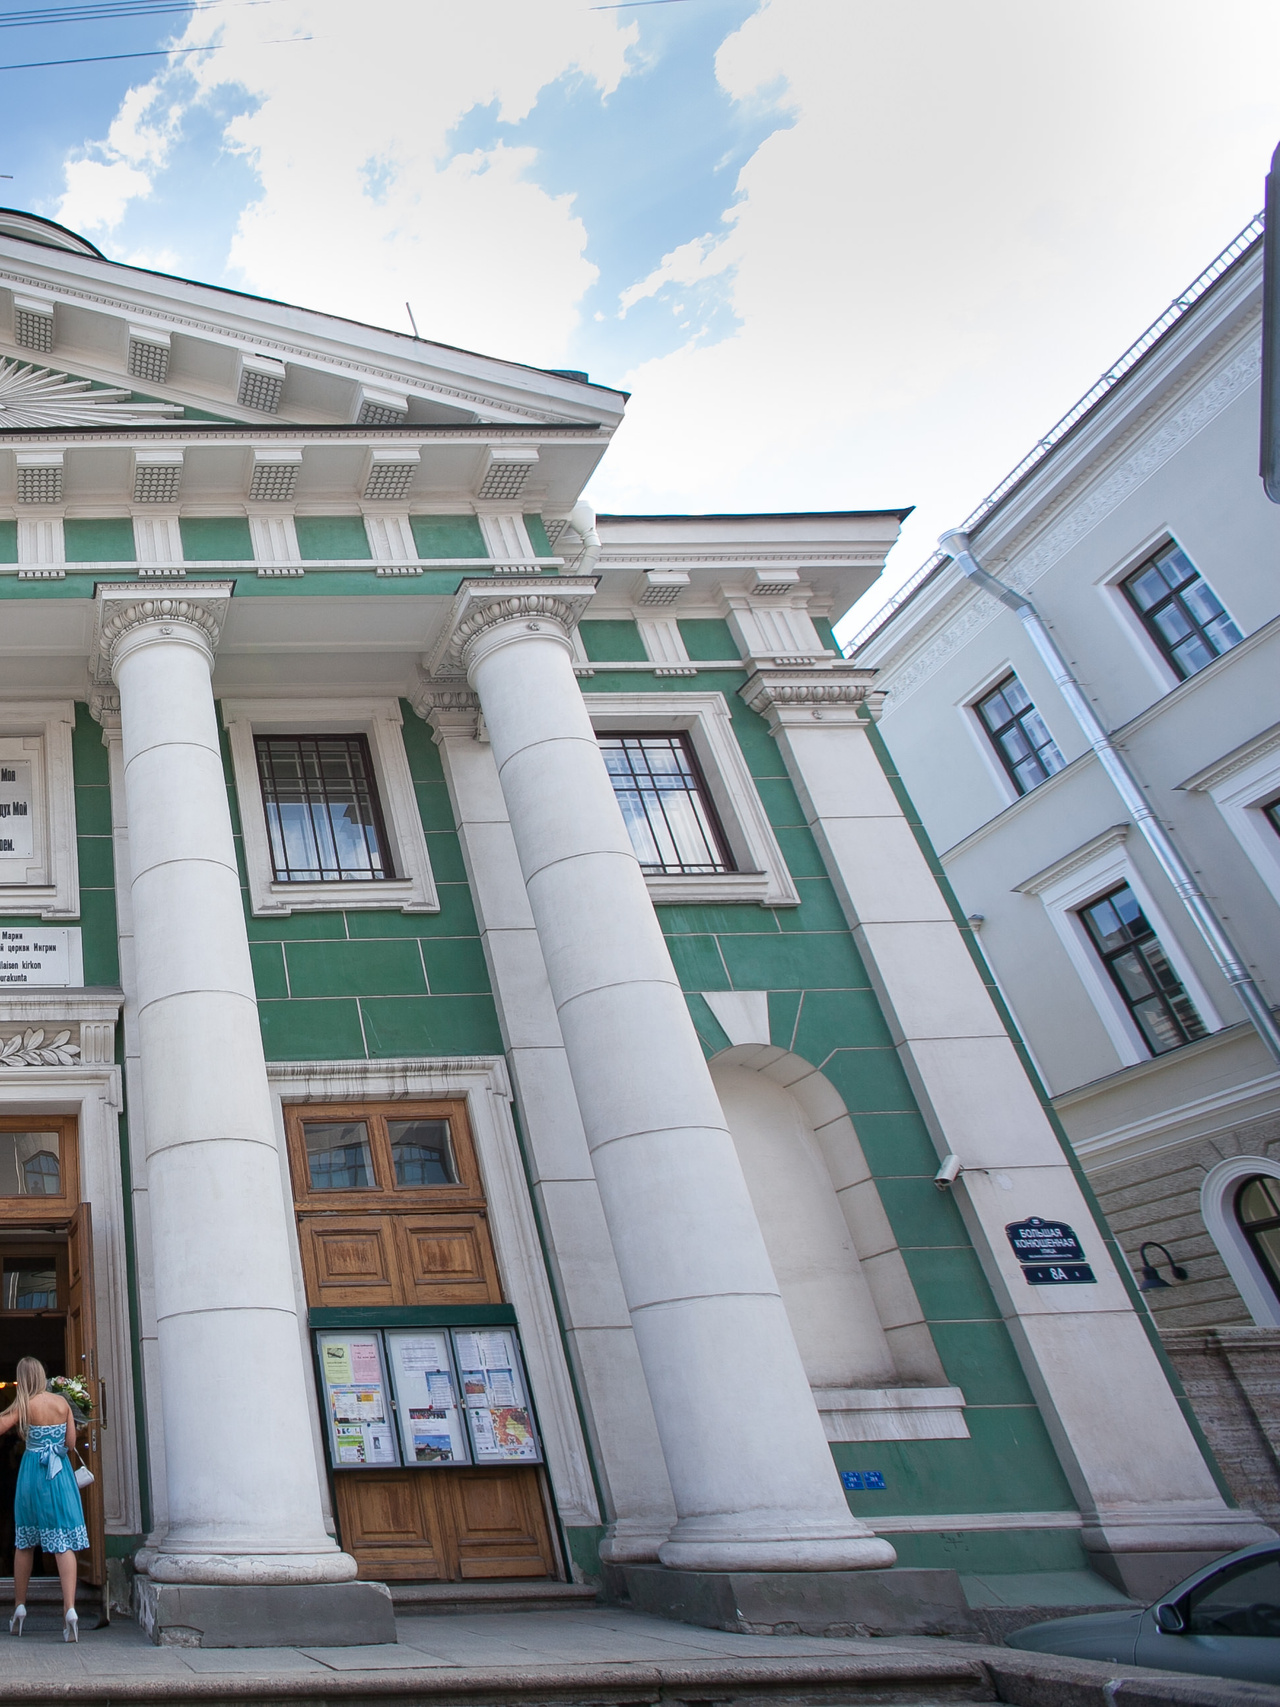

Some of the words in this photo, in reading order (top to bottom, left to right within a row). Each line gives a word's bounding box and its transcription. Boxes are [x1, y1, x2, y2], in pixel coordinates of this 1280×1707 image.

[1, 768, 16, 782] Моя
[12, 802, 28, 816] Мой
[1, 931, 23, 942] Марии
[7, 945, 30, 954] церкви
[33, 942, 57, 954] Ингрии
[21, 960, 42, 970] kirkon
[1018, 1228, 1063, 1238] БОЛЬШАЯ
[1014, 1238, 1076, 1248] КОНЮШЕННАЯ
